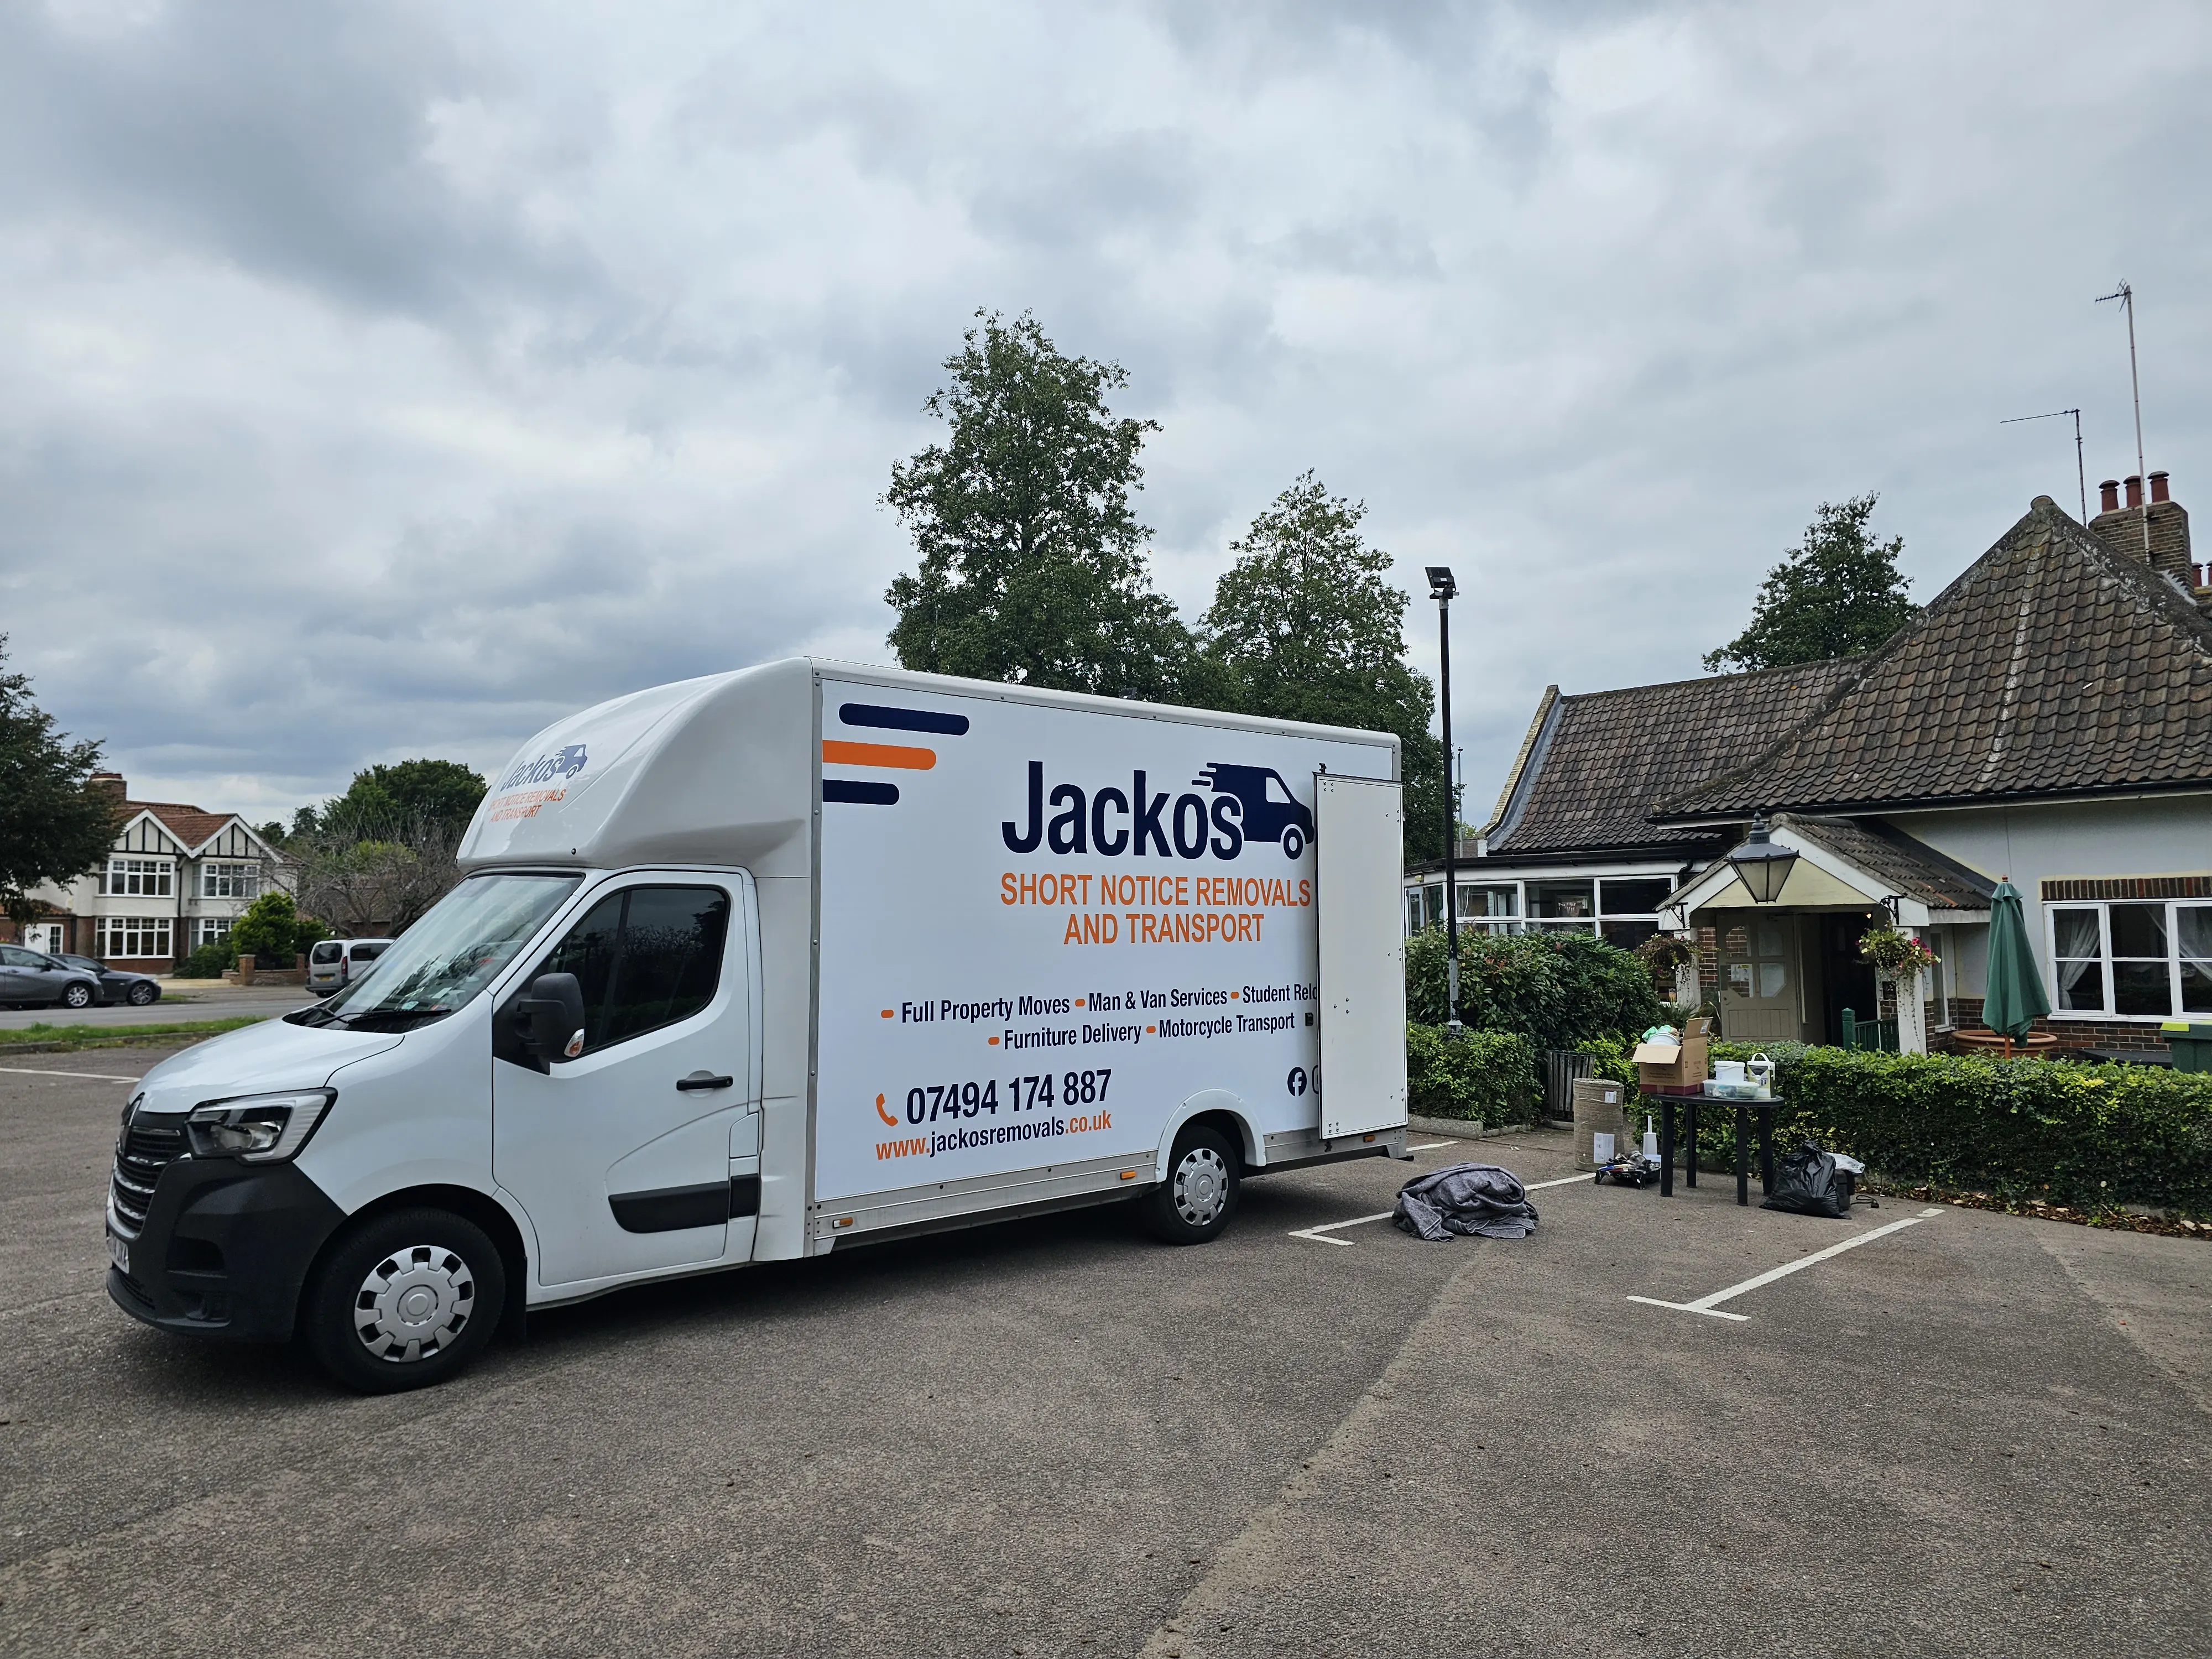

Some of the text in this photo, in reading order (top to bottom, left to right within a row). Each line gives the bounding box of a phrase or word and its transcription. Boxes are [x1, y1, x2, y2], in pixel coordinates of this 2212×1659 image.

[500, 754, 565, 792] Jackos
[501, 805, 542, 821] TRANSPORT
[524, 789, 566, 804] REMOVALS
[1001, 760, 1243, 860] Jackos
[1000, 872, 1311, 906] SHORT NOTICE REMOVALS
[1064, 913, 1265, 945] AND TRANSPORT
[902, 1000, 934, 1024] Full
[941, 998, 1014, 1024] Property
[1019, 995, 1070, 1016] Moves
[1089, 992, 1120, 1012] Man
[1125, 991, 1136, 1010] &
[1140, 989, 1166, 1009] Van
[1171, 988, 1228, 1008] Services
[1243, 984, 1291, 1004] Student
[1004, 1012, 1295, 1051] Furniture Delivery Motorcycle Transport
[906, 1068, 1112, 1125] 07494 174 887
[875, 1110, 1112, 1160] www.jackosremovals.co.uk
